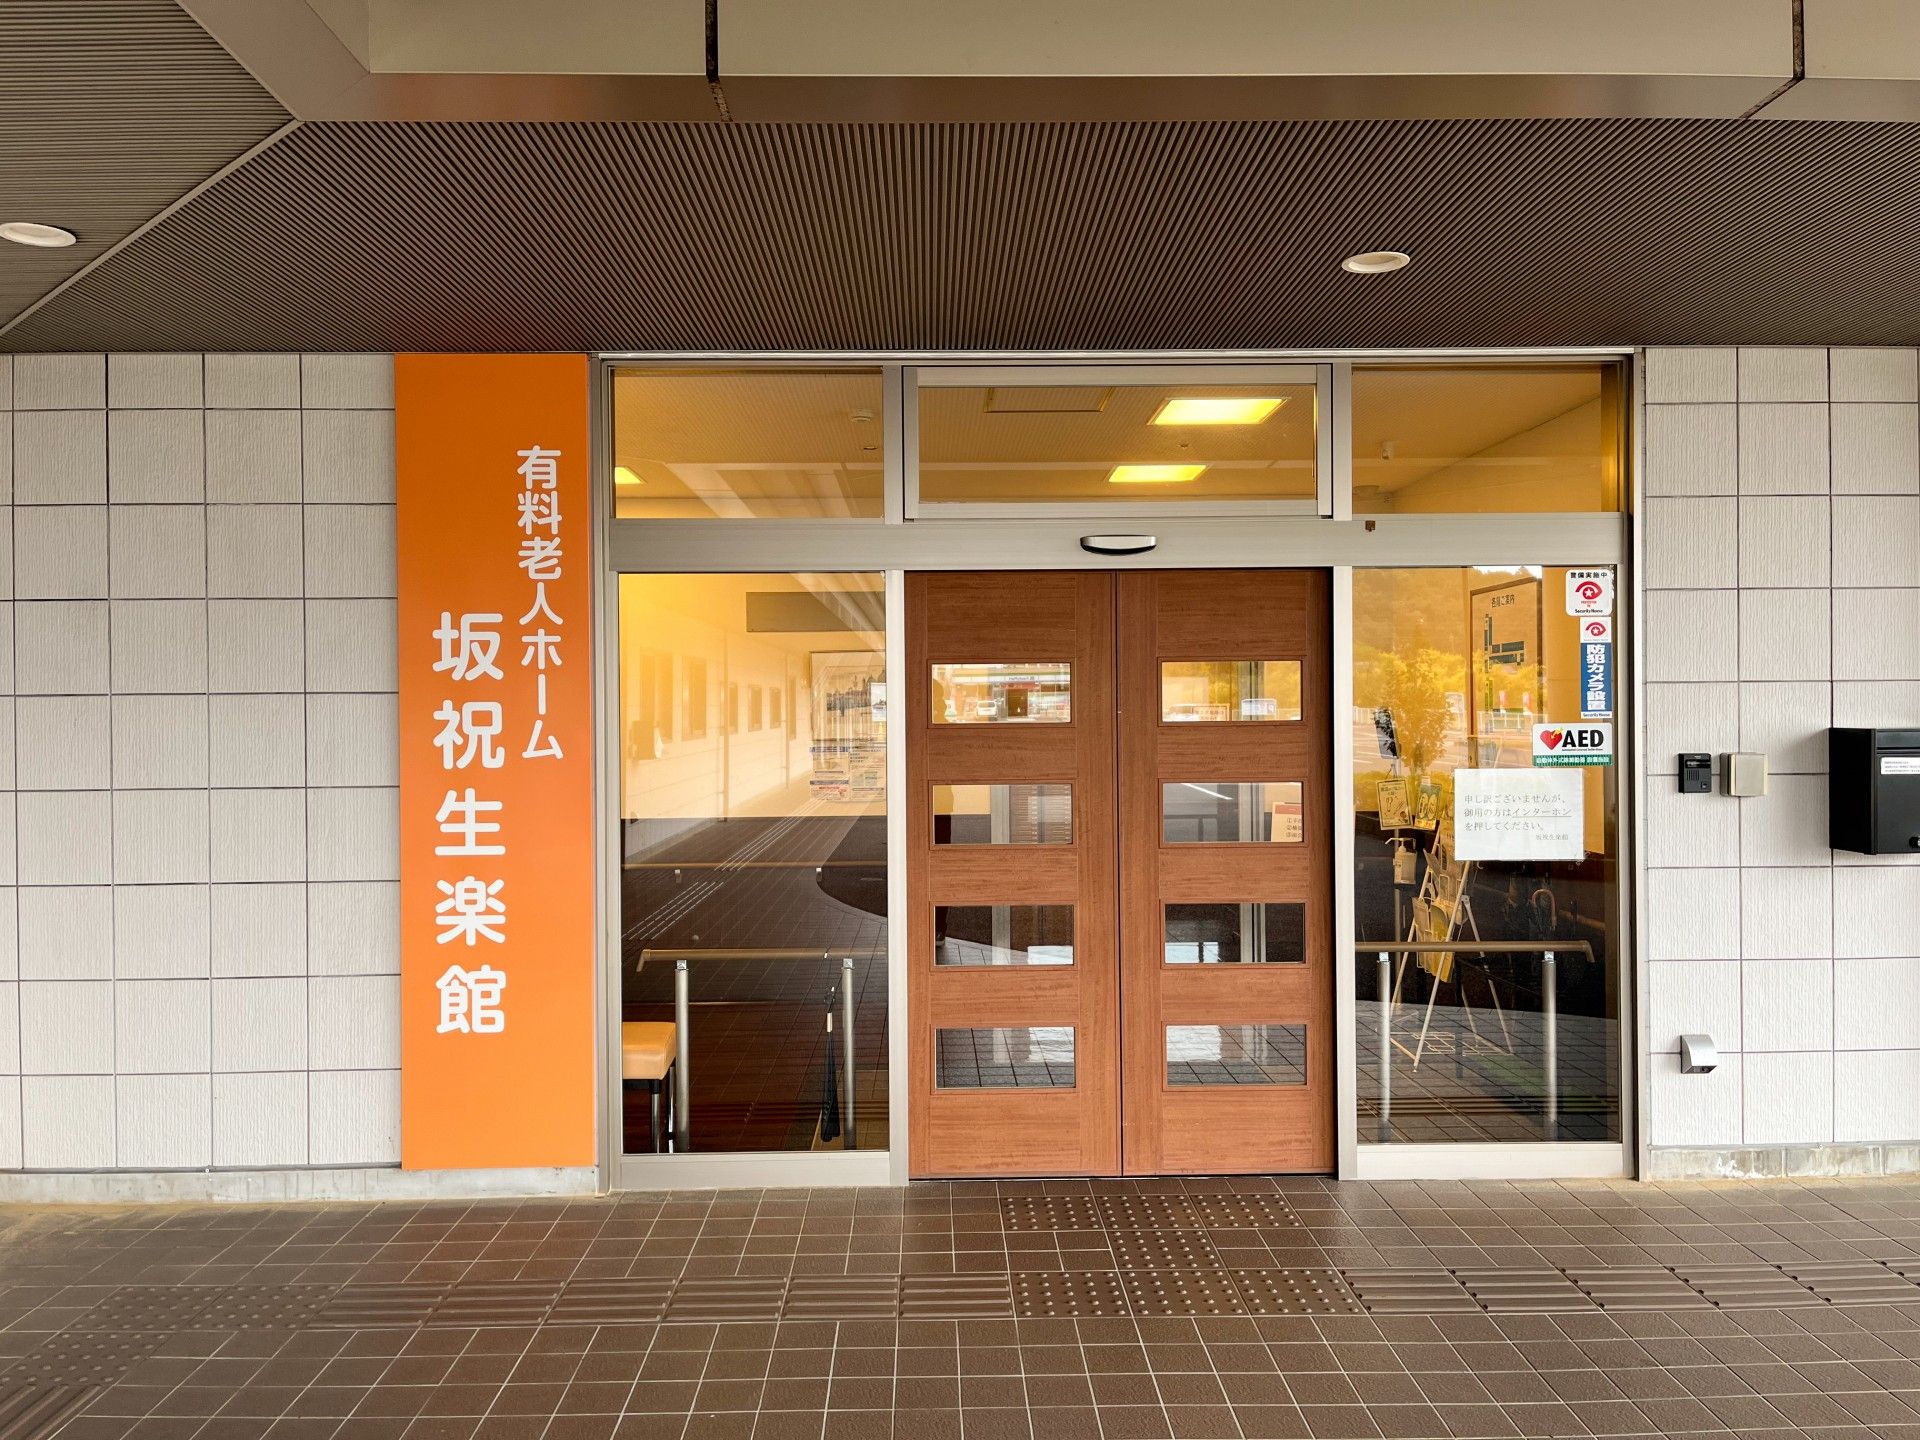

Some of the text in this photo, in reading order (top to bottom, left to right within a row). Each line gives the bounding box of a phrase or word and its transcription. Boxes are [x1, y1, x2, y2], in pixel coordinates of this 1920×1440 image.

[516, 444, 564, 760] 有料老人ホーム
[1586, 644, 1606, 711] 防犯カメラ設置
[1561, 729, 1604, 748] AED
[431, 611, 507, 1036] 坂祝生楽館
[1464, 808, 1572, 817] 御用の方はインターホン
